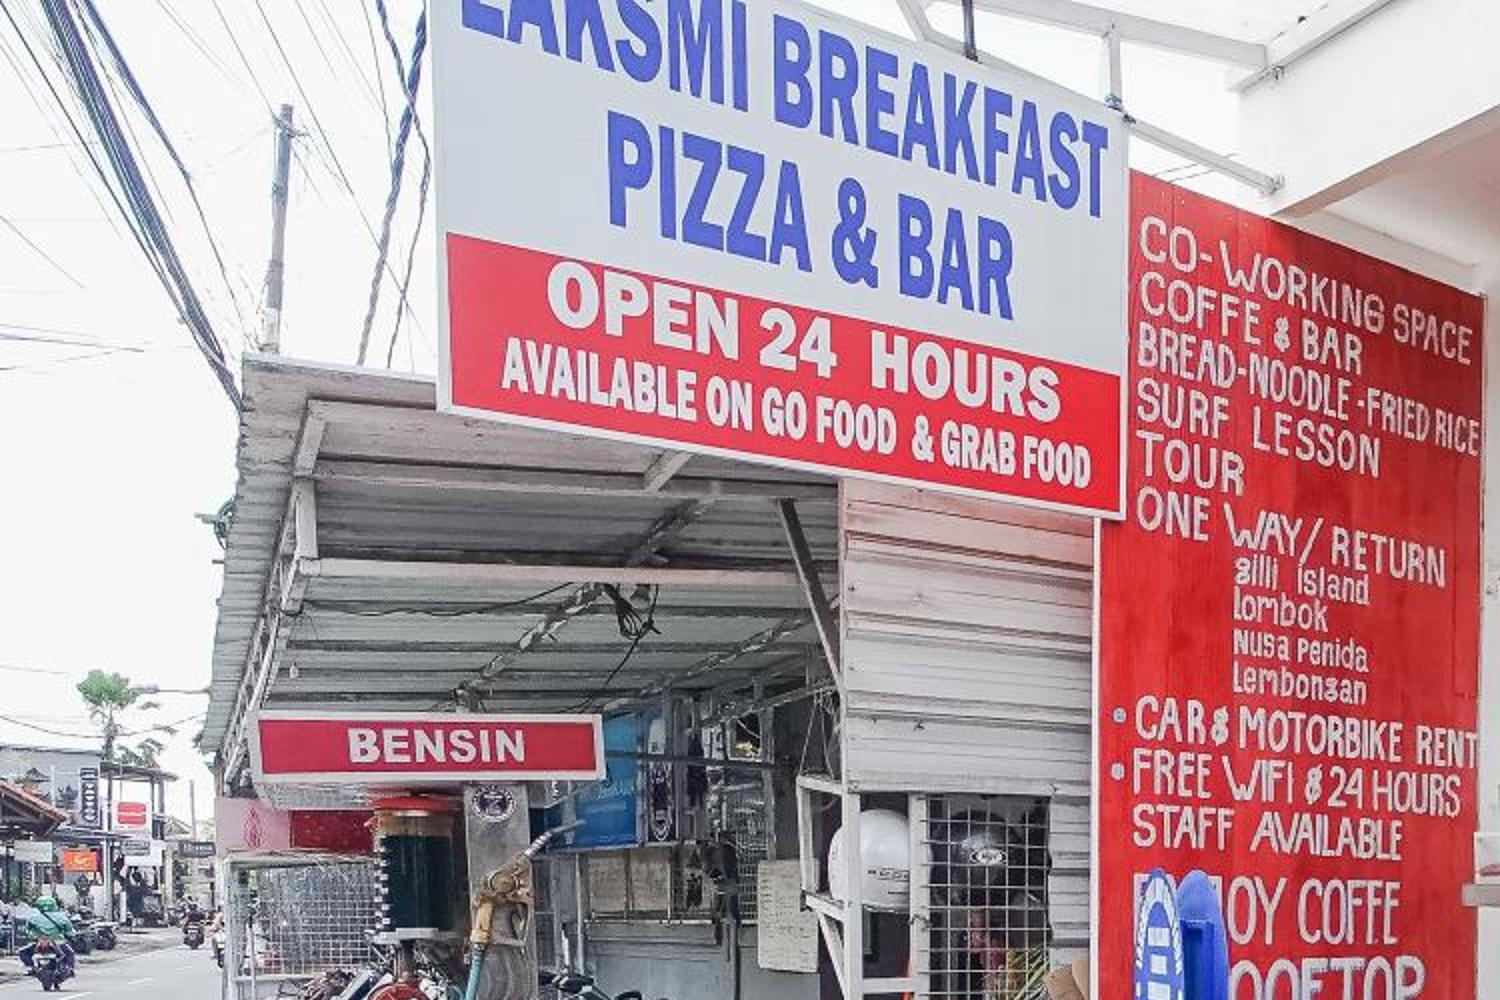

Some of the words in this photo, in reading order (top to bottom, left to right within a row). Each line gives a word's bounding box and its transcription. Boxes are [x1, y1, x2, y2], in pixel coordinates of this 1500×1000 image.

[461, 0, 749, 112] KSMI
[773, 13, 1109, 218] BREAKFAST
[607, 109, 812, 273] PIZZA
[831, 177, 878, 289] &
[898, 193, 1014, 321] BAR
[1138, 216, 1385, 334] CO-WORKING
[1393, 304, 1473, 366] SPACE
[1140, 272, 1261, 345] COFFE
[1273, 317, 1291, 353] &
[1303, 319, 1363, 375] BAR
[546, 260, 740, 360] OPEN
[758, 310, 838, 378] 24
[870, 331, 1061, 423] HOURS
[502, 337, 697, 423] AVAILABLE
[706, 375, 753, 435] ON
[761, 388, 807, 442] GO
[816, 396, 897, 455] FOOD
[911, 416, 935, 462] &
[940, 423, 1016, 479] GRAB
[1022, 438, 1092, 489] FOOD
[1137, 377, 1231, 440] SURF
[1252, 405, 1382, 479] LESSON
[1435, 408, 1481, 457] RICE
[1136, 430, 1246, 497] TOUR
[1137, 487, 1210, 542] ONE
[1331, 526, 1446, 588] RETURN
[1232, 660, 1367, 705] Lembongan
[347, 728, 526, 763] BENSIN
[1239, 705, 1403, 763] MOTORBIKE
[1415, 725, 1479, 769] RENT
[1132, 747, 1213, 799] FREE
[1222, 754, 1294, 805] WIFI
[1328, 765, 1364, 810] 24
[1371, 768, 1463, 819] HOURS
[1131, 803, 1235, 851] STAFF
[1250, 810, 1403, 861] AVAILABLE
[1298, 878, 1400, 945] COFFE
